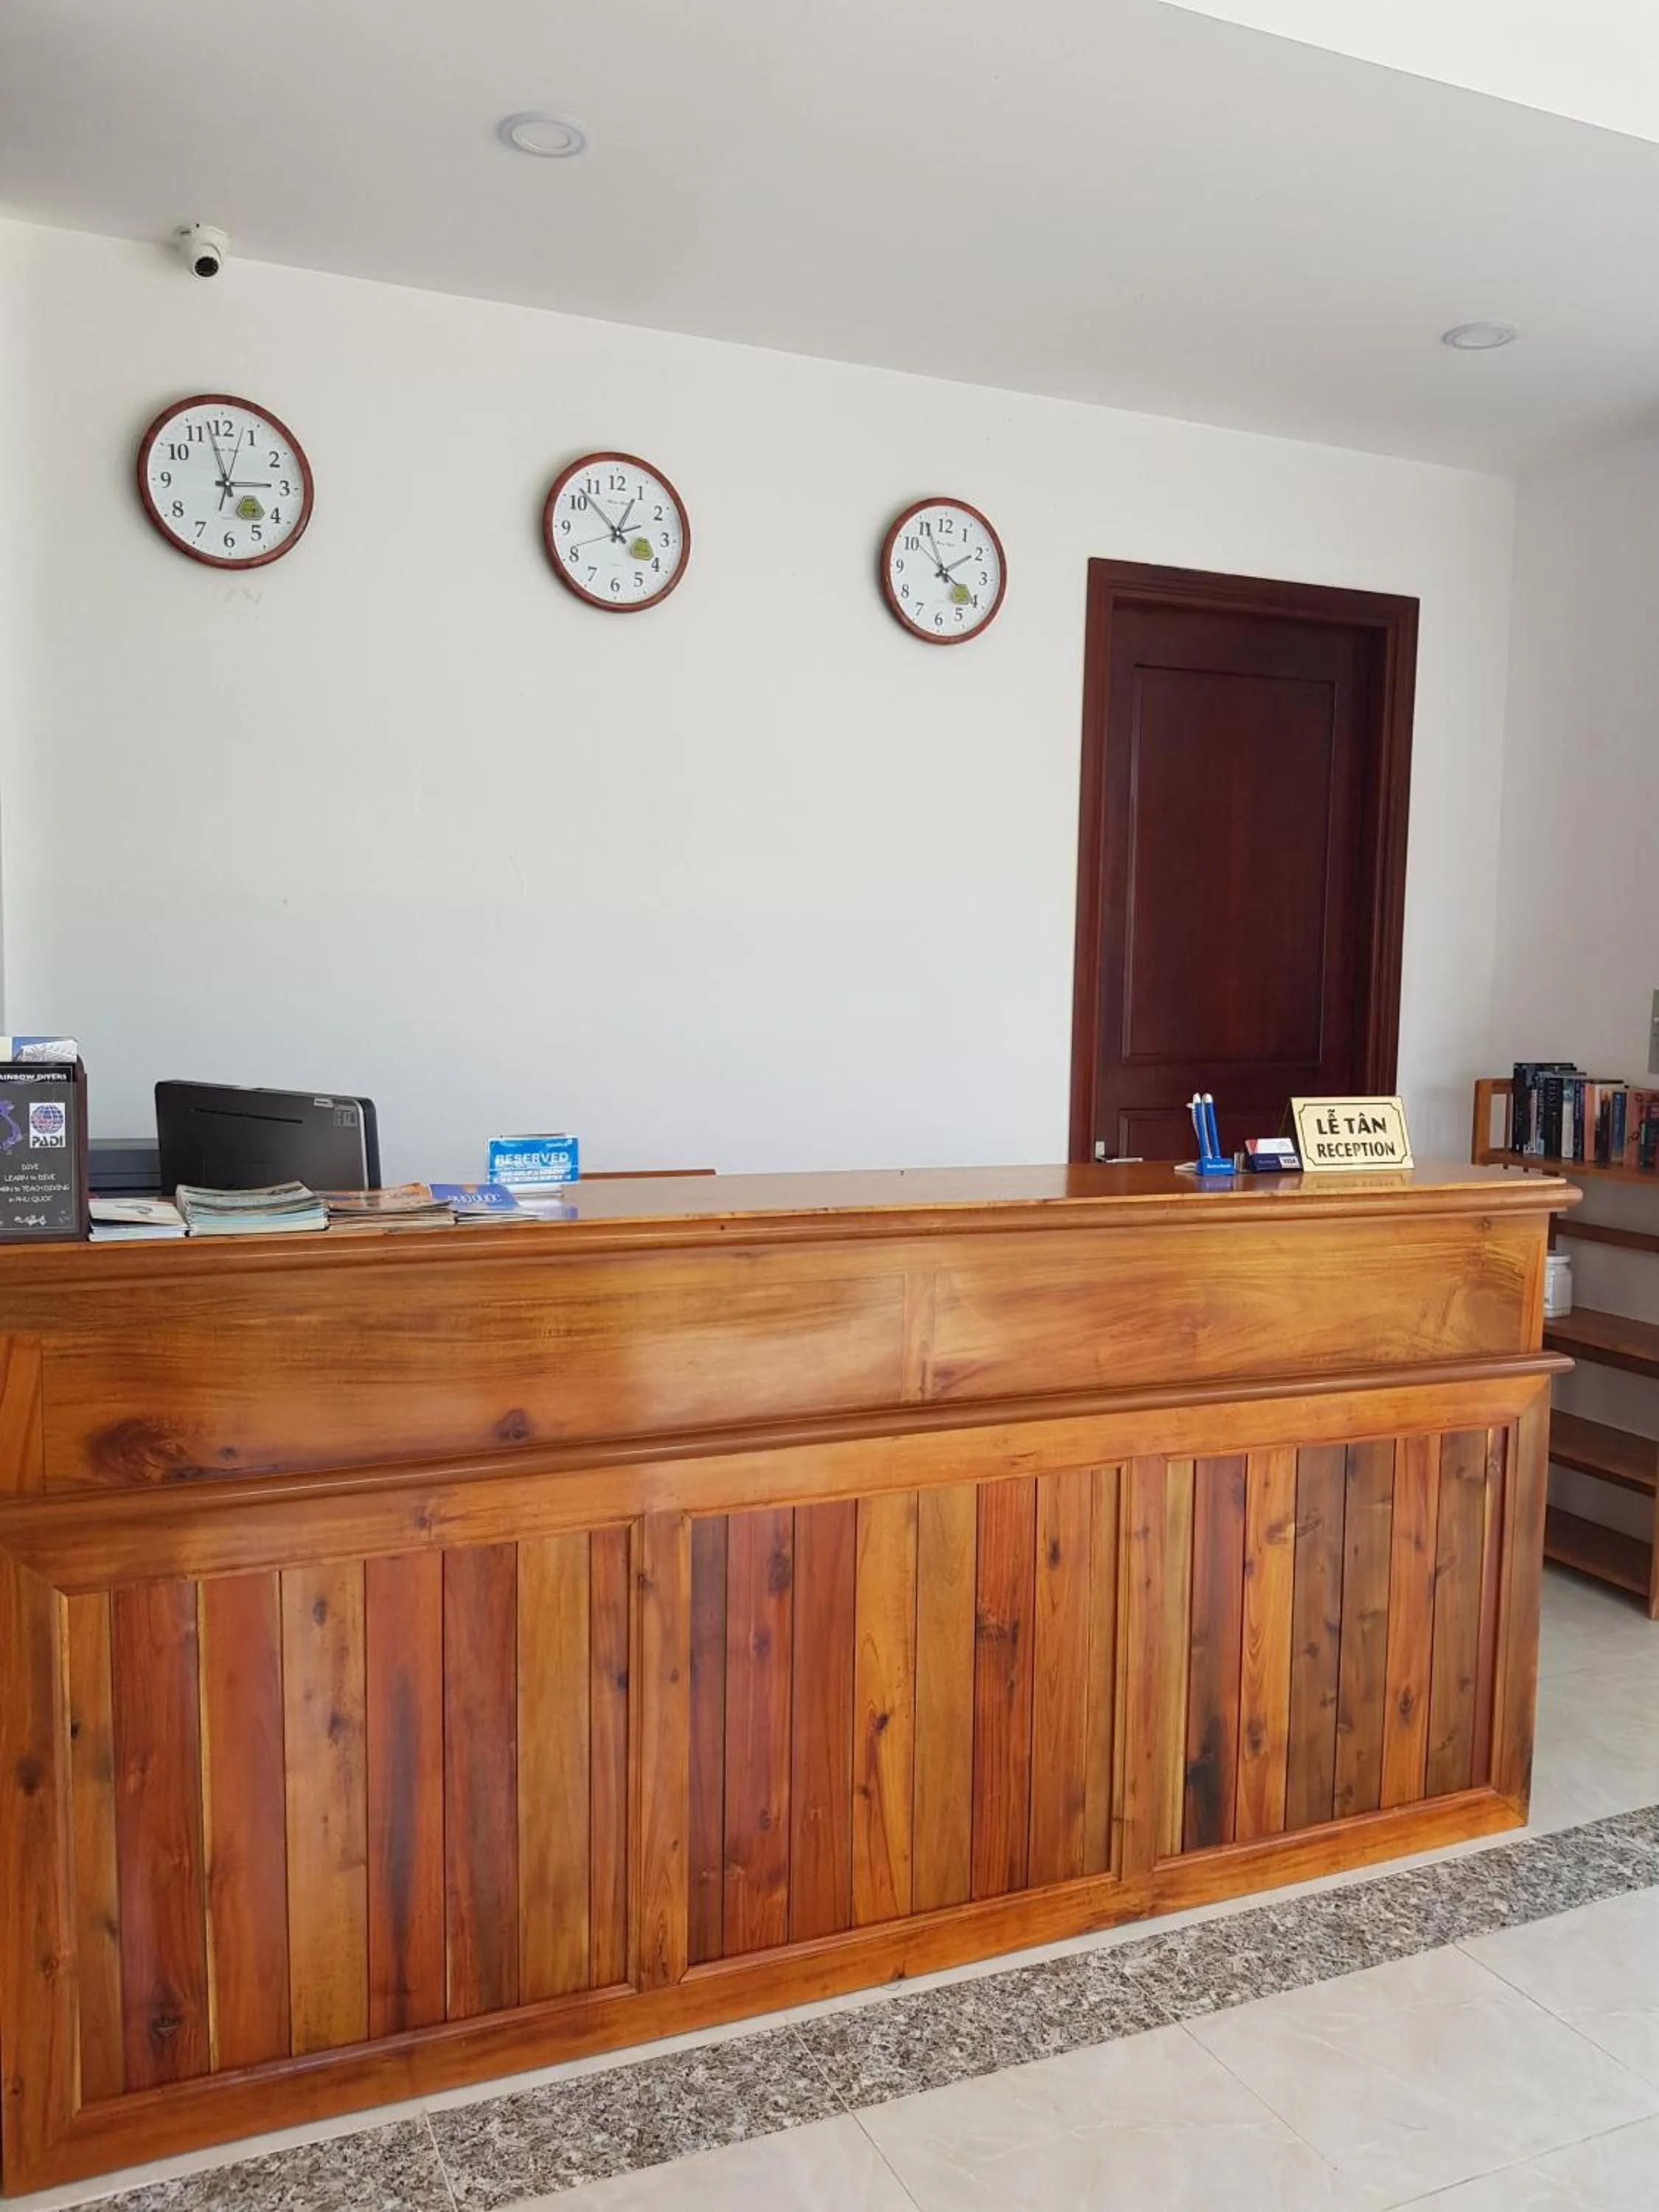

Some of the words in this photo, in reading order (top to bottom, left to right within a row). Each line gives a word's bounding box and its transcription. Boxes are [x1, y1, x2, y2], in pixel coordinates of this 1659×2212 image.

[187, 425, 204, 442] 11
[213, 420, 234, 437] 12
[248, 431, 255, 445] 1
[169, 444, 189, 460] 10
[269, 452, 280, 467] 2
[161, 472, 171, 487] 9
[586, 479, 600, 494] 11
[609, 476, 626, 491] 12
[279, 481, 290, 496] 3
[638, 487, 644, 500] 1
[173, 501, 184, 517] 8
[571, 495, 587, 510] 10
[271, 508, 281, 523] 4
[653, 507, 663, 521] 2
[195, 522, 206, 537] 7
[251, 525, 262, 540] 5
[562, 521, 571, 535] 9
[919, 522, 931, 536] 11
[938, 519, 953, 533] 12
[224, 532, 235, 547] 6
[661, 533, 669, 547] 3
[962, 529, 968, 542] 1
[905, 537, 919, 550] 10
[569, 547, 579, 562] 8
[975, 548, 983, 560] 2
[652, 558, 660, 572] 4
[897, 560, 904, 572] 9
[588, 567, 597, 581] 7
[634, 572, 644, 587] 5
[979, 572, 987, 585] 3
[611, 578, 619, 591] 6
[902, 585, 909, 598] 8
[916, 602, 924, 616] 7
[955, 608, 963, 621] 5
[935, 613, 942, 625] 6
[1316, 1109, 1340, 1135] LỄ
[1343, 1112, 1387, 1135] TÂN
[32, 1135, 63, 1147] PADI
[1317, 1142, 1396, 1159] RECEPTION
[495, 1152, 569, 1166] RESERVED
